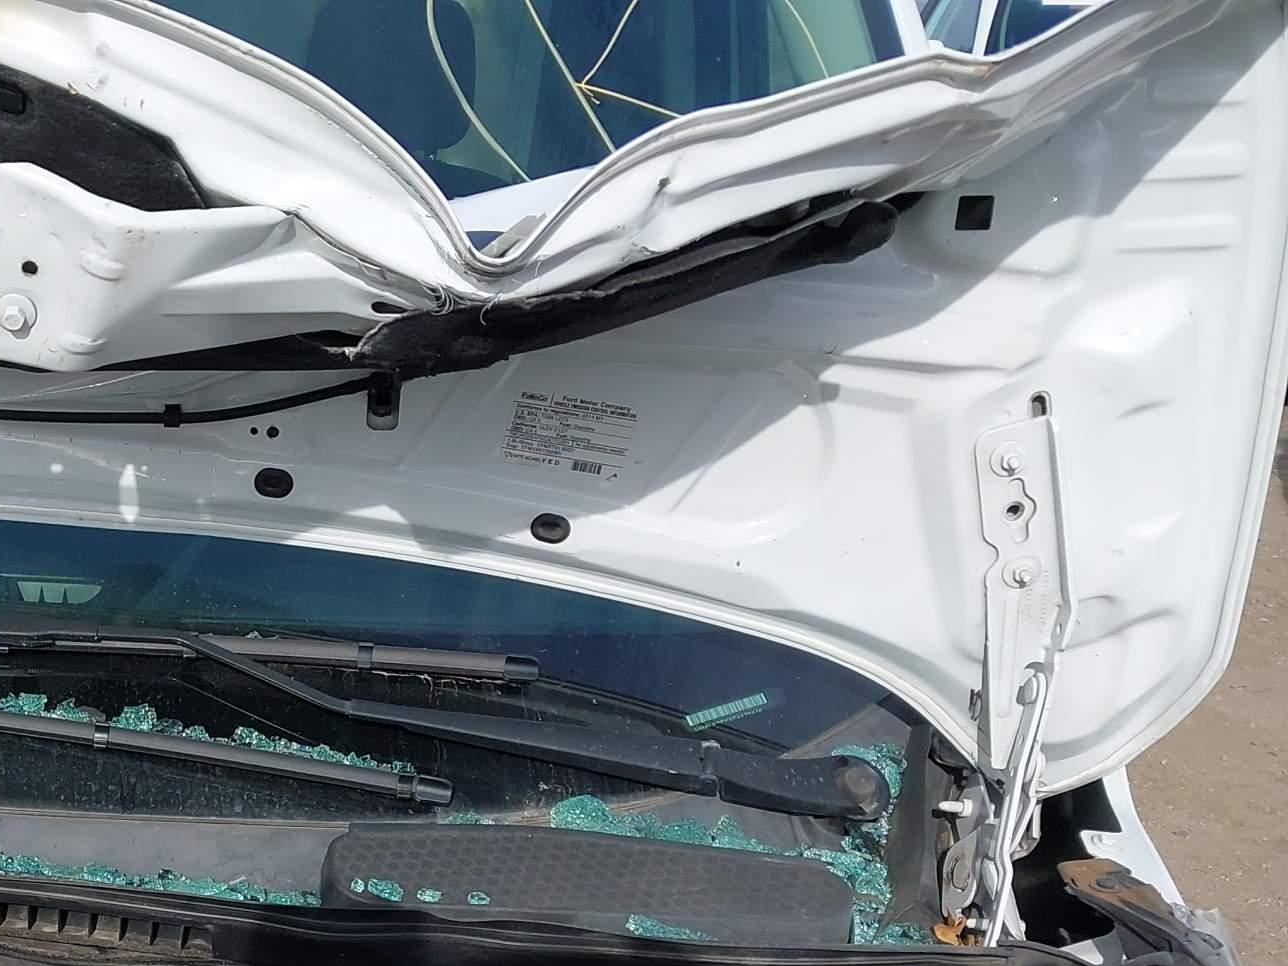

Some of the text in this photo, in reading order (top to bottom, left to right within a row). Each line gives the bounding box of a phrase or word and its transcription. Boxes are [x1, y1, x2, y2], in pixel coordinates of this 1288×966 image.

[563, 395, 632, 412] Ford Motor Company
